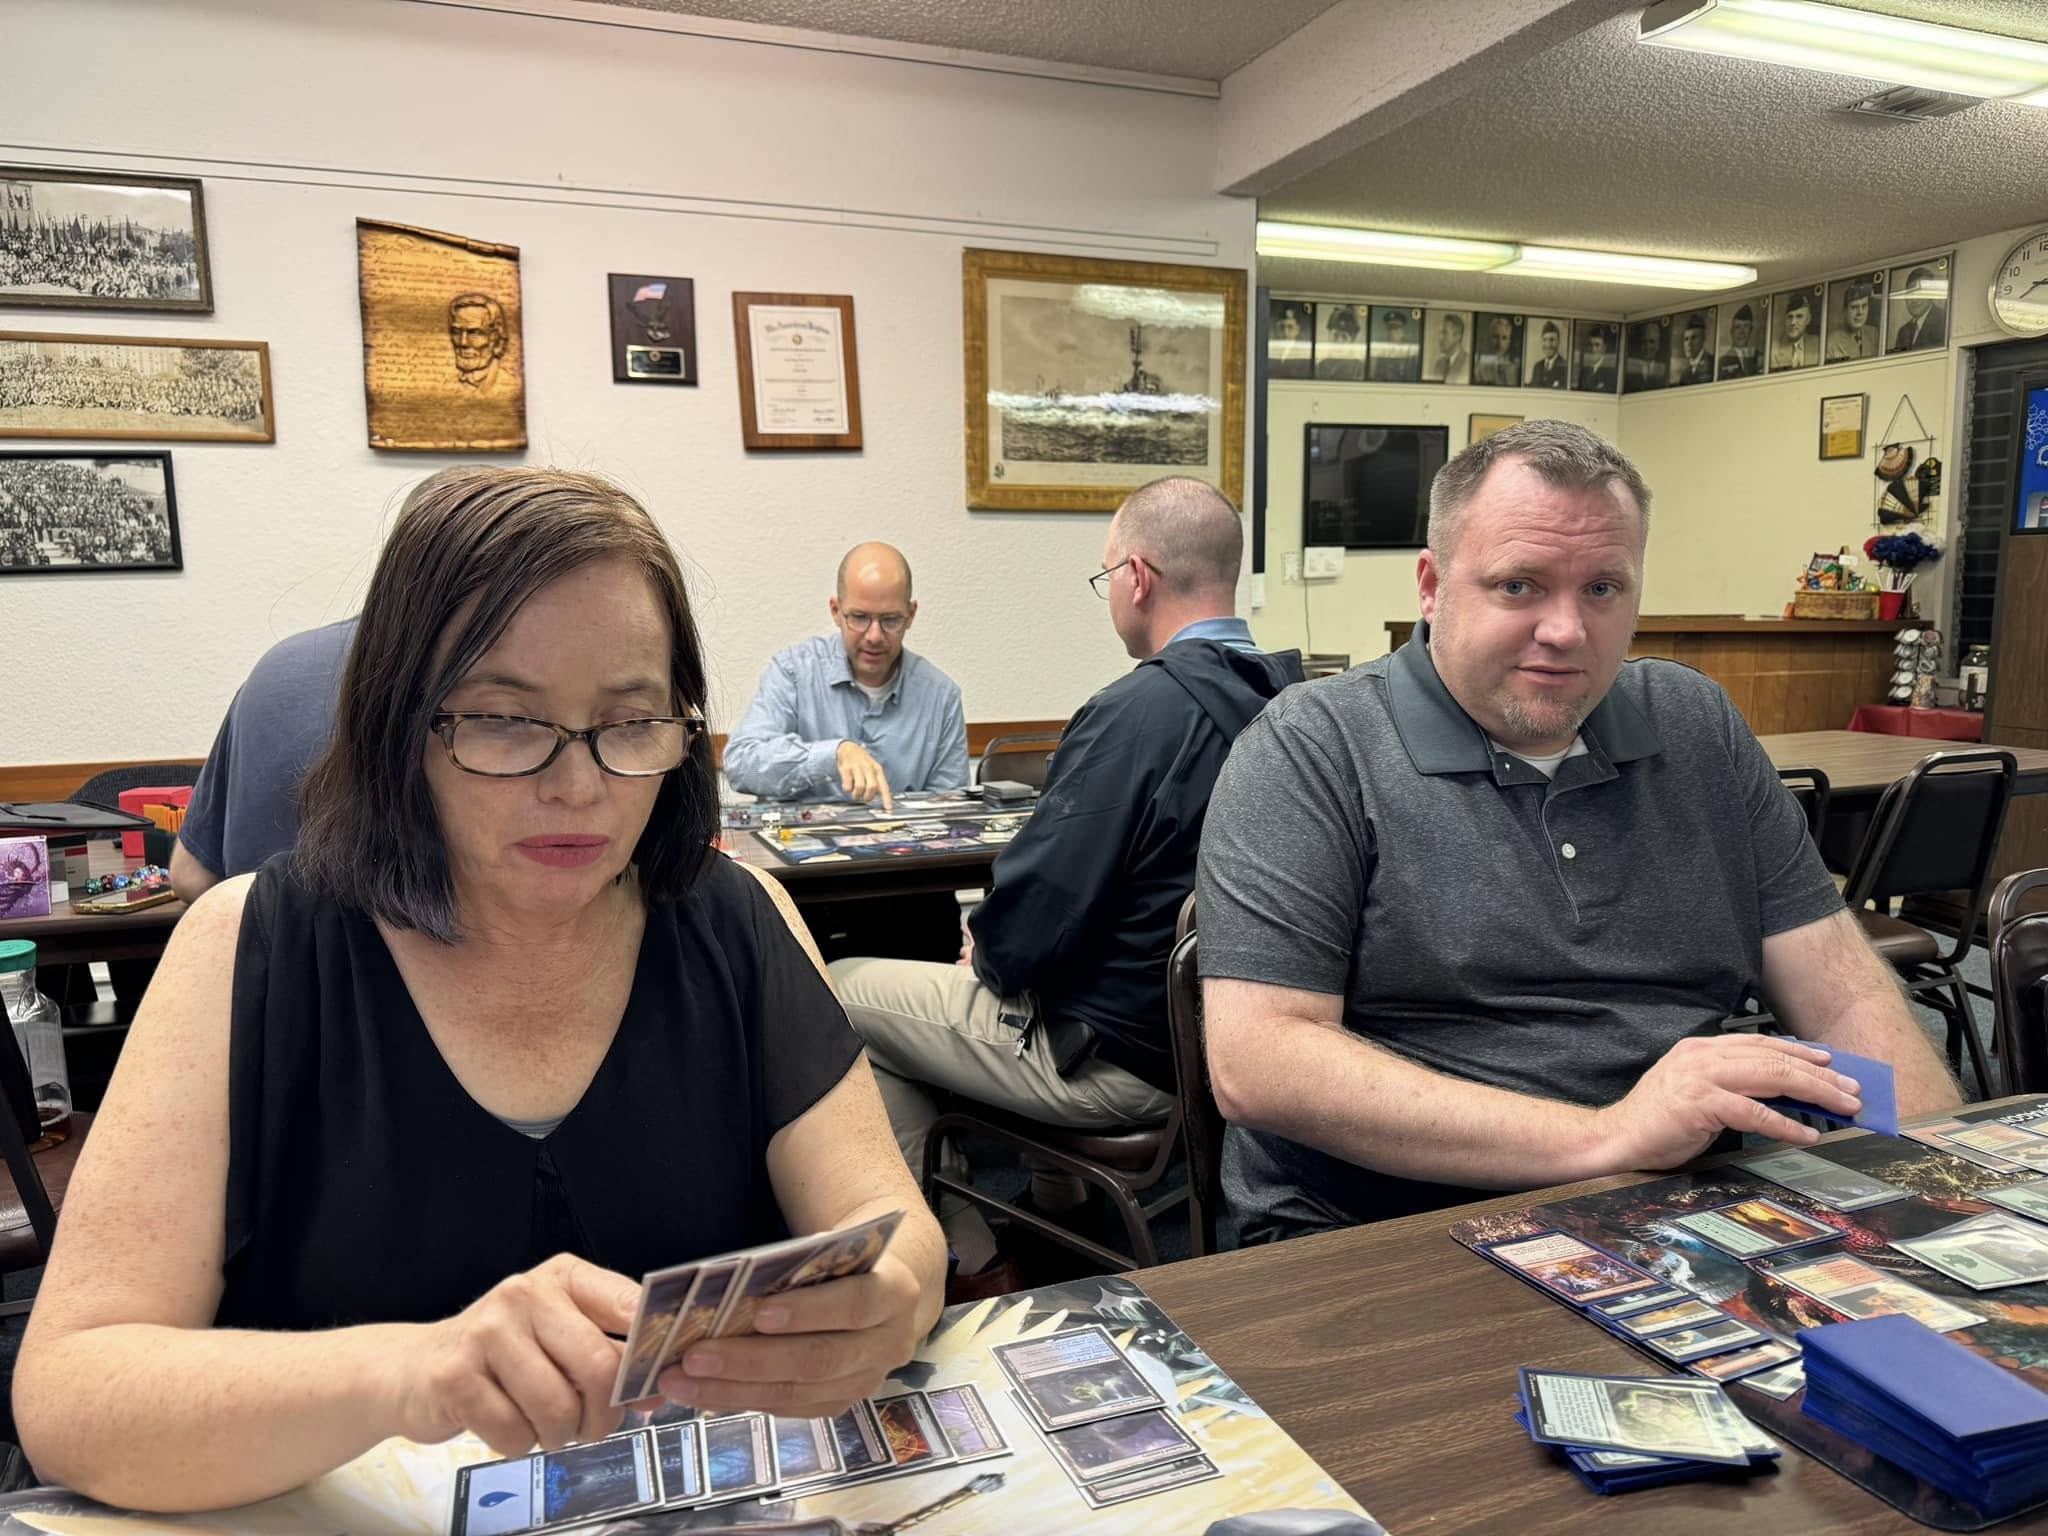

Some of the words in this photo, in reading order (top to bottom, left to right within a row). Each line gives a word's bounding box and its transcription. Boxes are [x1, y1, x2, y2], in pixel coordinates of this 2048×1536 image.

[2022, 250, 2030, 261] 11
[2009, 266, 2020, 278] 10
[2004, 285, 2013, 296] 9
